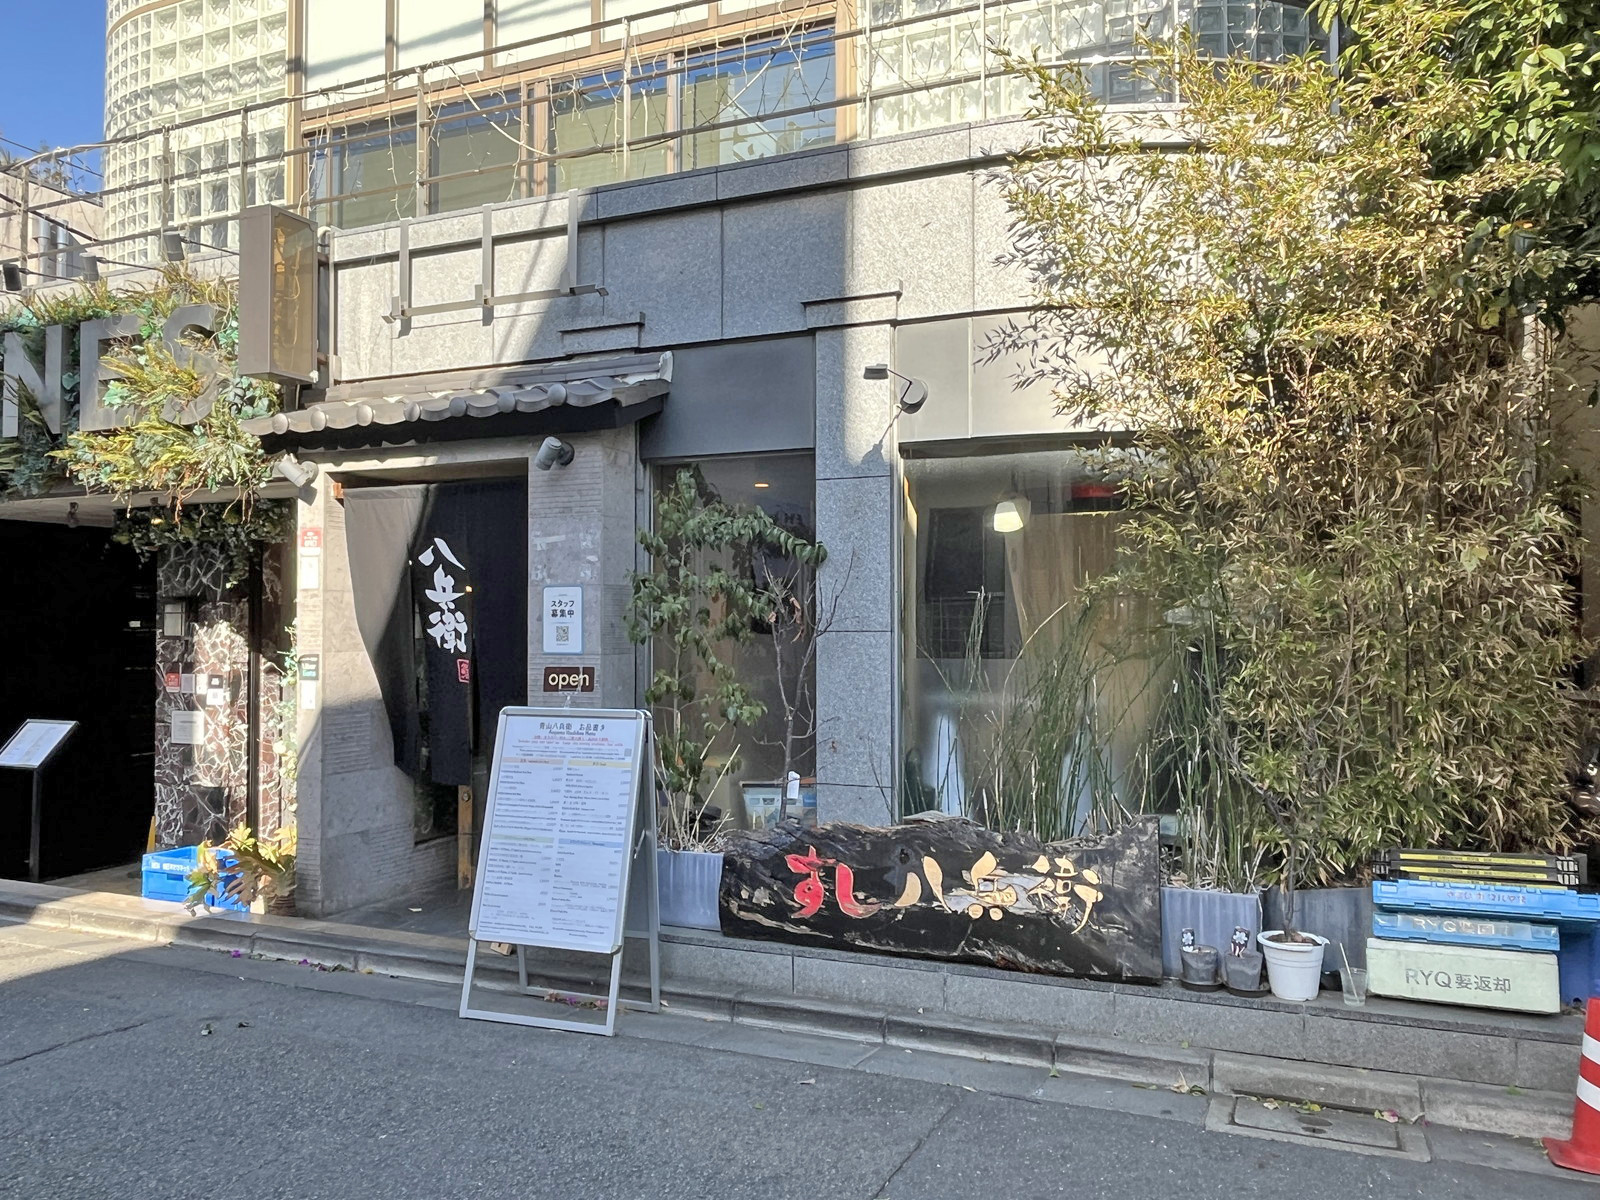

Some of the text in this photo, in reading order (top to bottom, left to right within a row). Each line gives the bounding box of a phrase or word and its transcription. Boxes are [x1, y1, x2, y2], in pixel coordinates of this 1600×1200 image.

[418, 537, 468, 653] 八兵衛
[551, 600, 575, 608] スタッフ
[551, 609, 575, 618] 募集中
[548, 673, 590, 690] open
